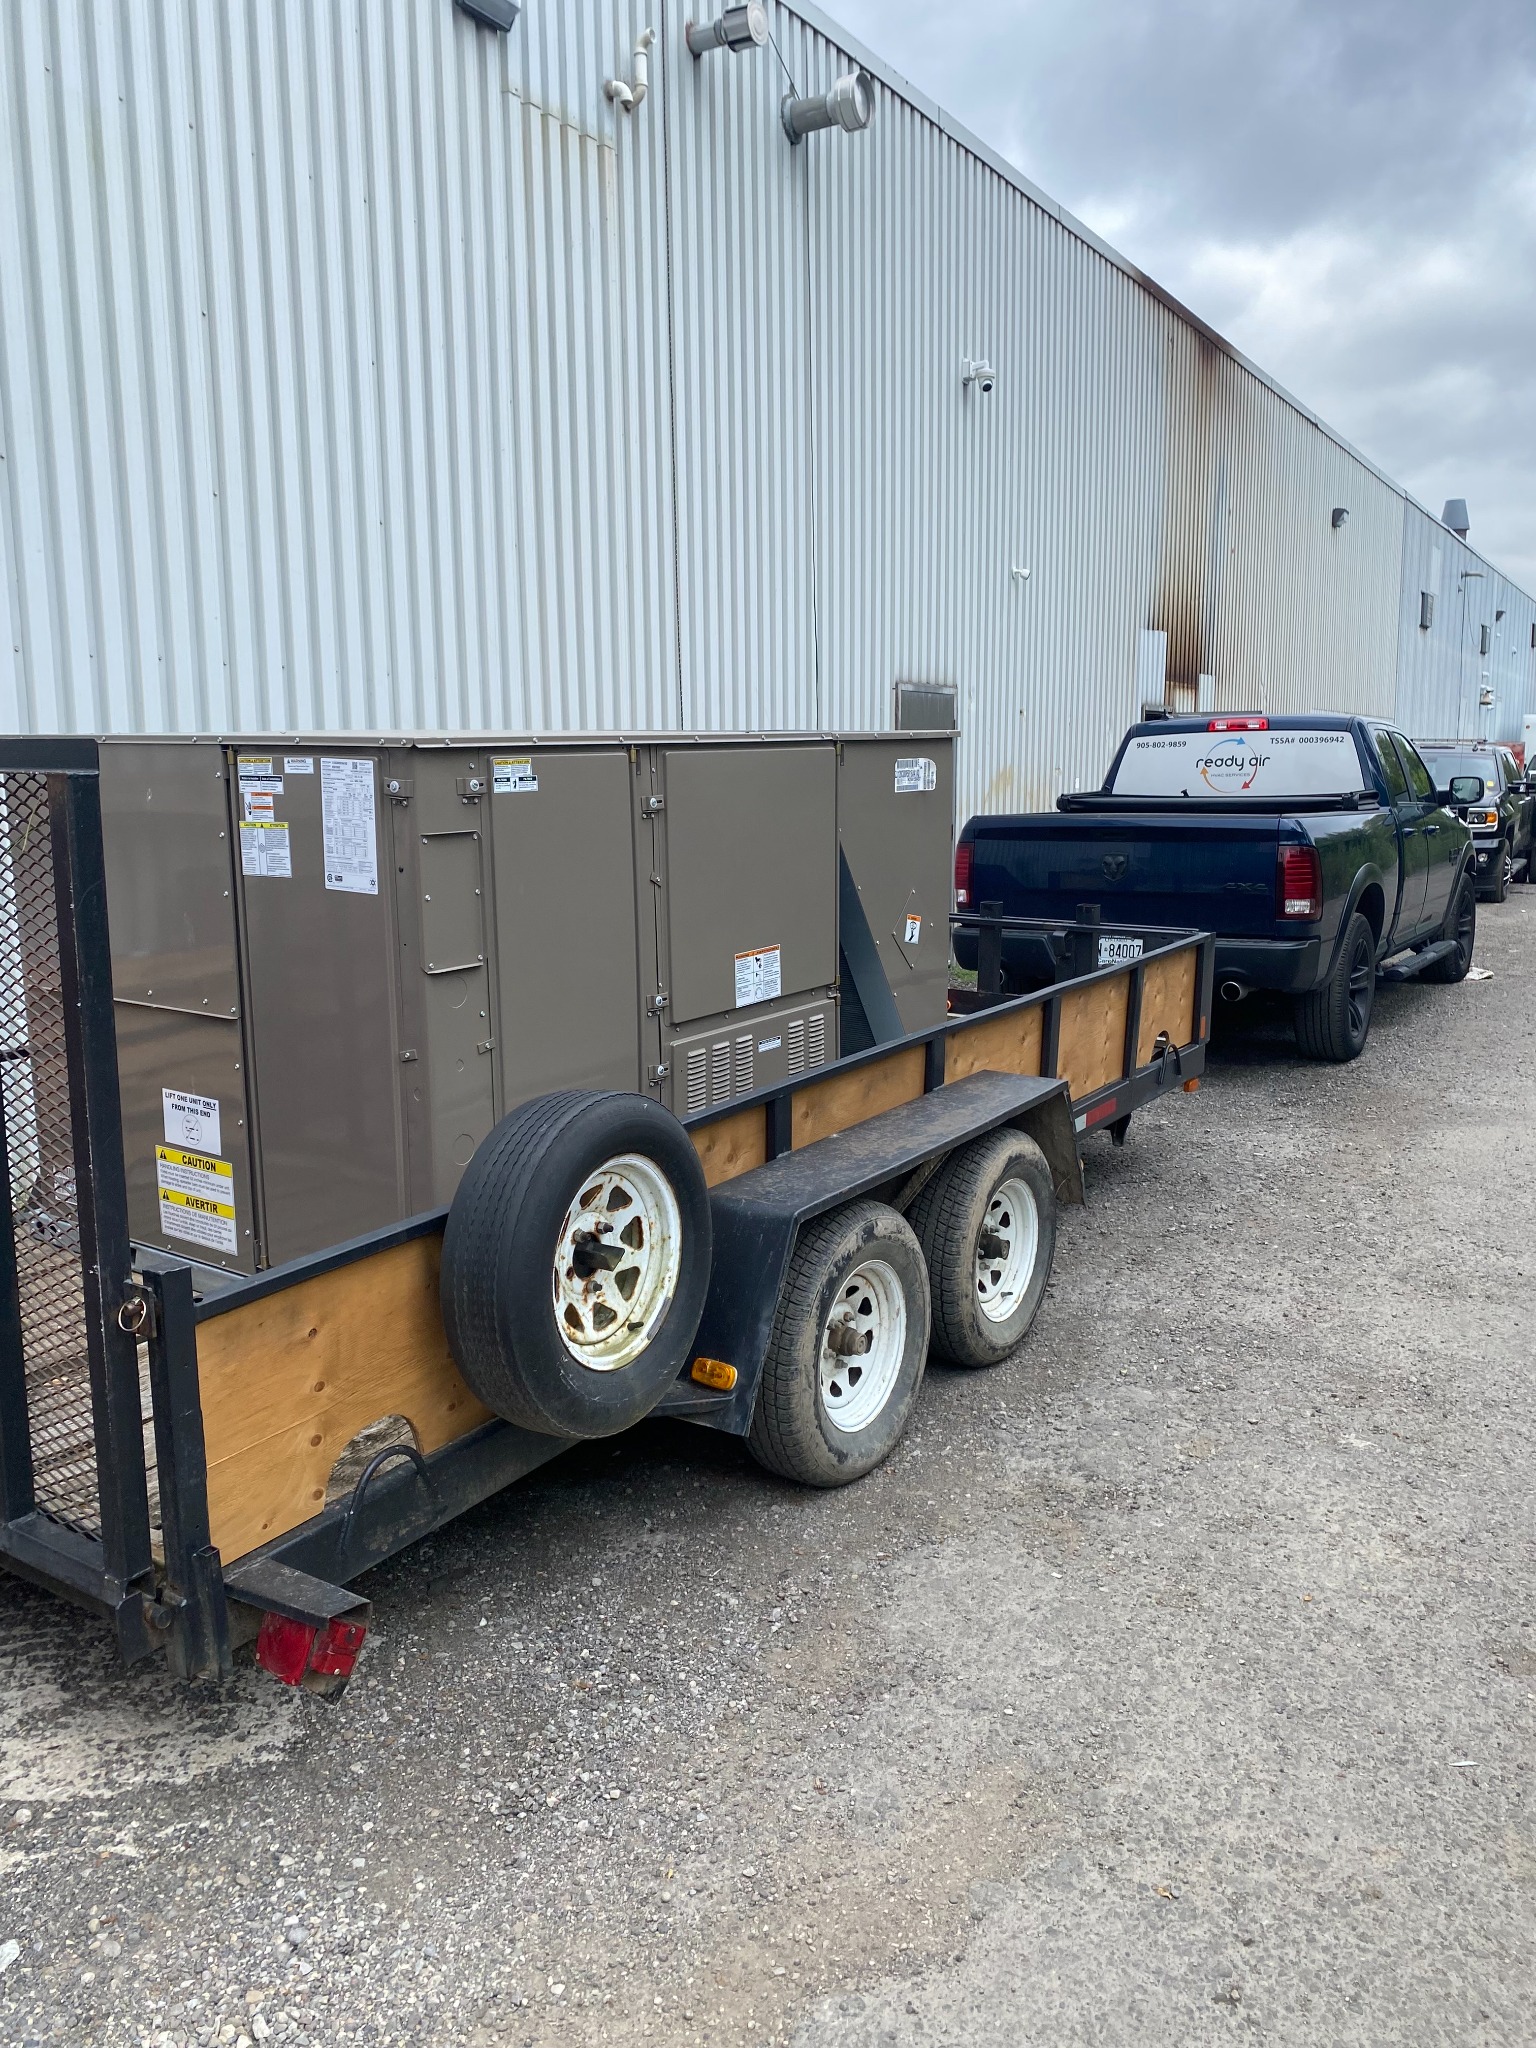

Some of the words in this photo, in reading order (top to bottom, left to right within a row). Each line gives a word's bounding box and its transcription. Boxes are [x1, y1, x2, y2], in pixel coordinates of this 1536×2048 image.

[1136, 740, 1187, 749] 905-802-9859
[1270, 737, 1295, 745] TSSA#
[1298, 736, 1345, 744] 000396942
[1196, 755, 1245, 771] ready
[1249, 754, 1271, 767] air
[165, 1092, 176, 1100] LIFT
[176, 1094, 188, 1102] ONE
[188, 1097, 202, 1106] UNIT
[202, 1100, 216, 1109] ONLY
[172, 1104, 186, 1112] FROM
[186, 1106, 199, 1115] THIS
[200, 1110, 211, 1118] END
[182, 1155, 216, 1172] CAUTION
[186, 1196, 218, 1214] AVERTIR
